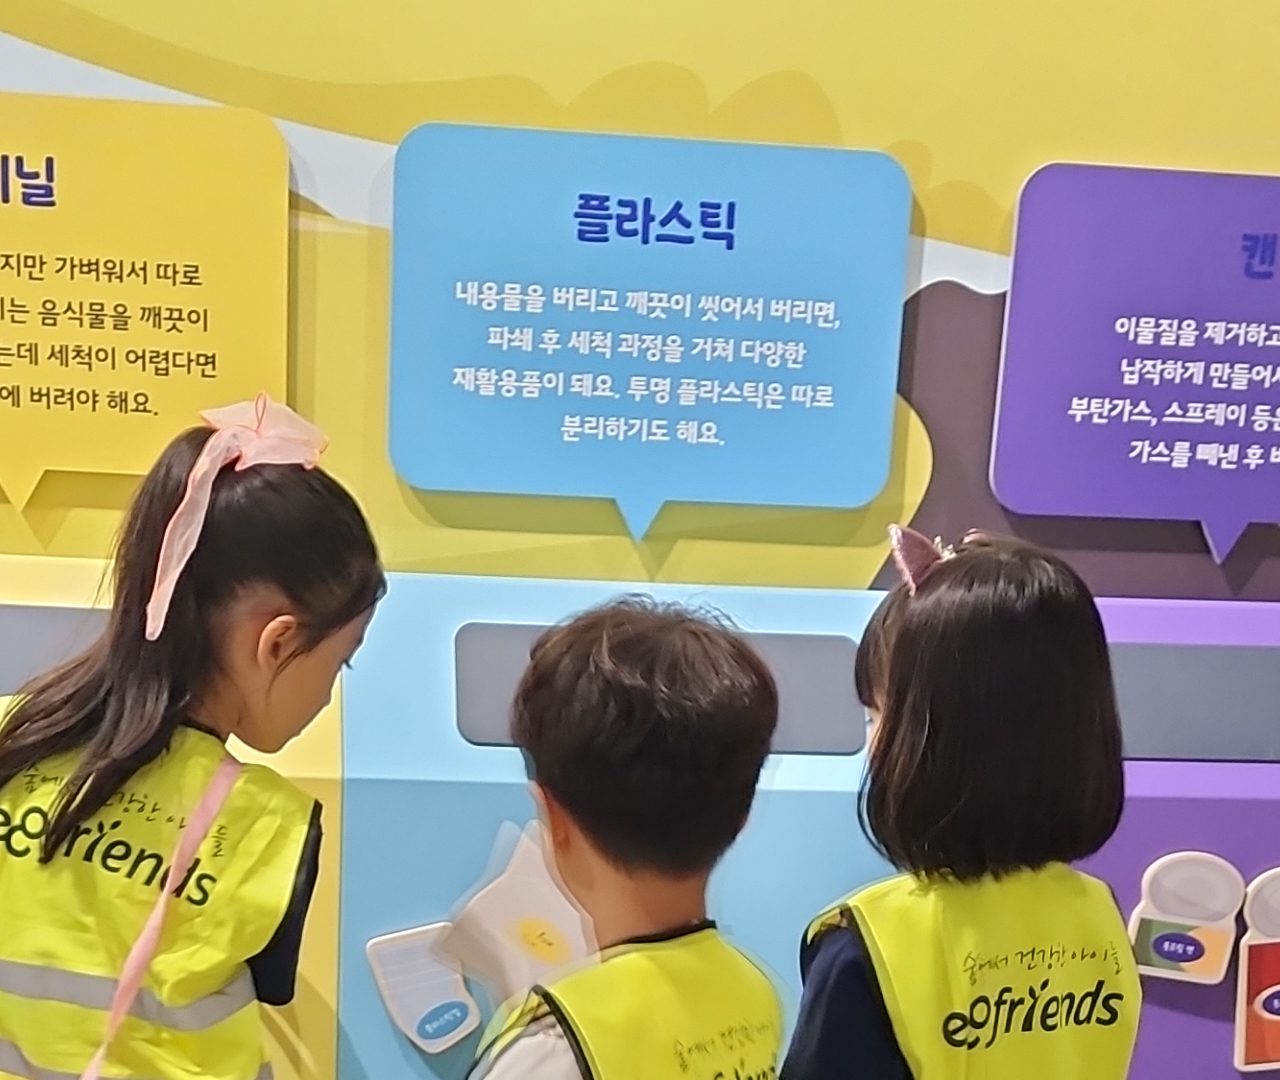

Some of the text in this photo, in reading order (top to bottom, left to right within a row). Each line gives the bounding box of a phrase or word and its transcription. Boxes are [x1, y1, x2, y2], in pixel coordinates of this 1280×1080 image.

[573, 193, 736, 251] 플라스틱
[54, 256, 148, 285] 가벼워서
[156, 263, 203, 287] 따로
[1241, 233, 1279, 281] 캔
[37, 299, 132, 332] 음식물을
[139, 306, 208, 334] 깨끗이
[455, 281, 841, 329] 내용물을 버리고 깨끗이 씻어서 버리면,
[487, 326, 807, 369] 파쇄 후 세척 과정을 거쳐 다양한
[1114, 316, 1199, 347] 이물질을
[47, 344, 116, 372] 세척이
[124, 348, 217, 379] 어렵다면
[1120, 358, 1205, 386] 납작하게
[29, 386, 100, 413] 버려야
[106, 390, 159, 416] 해요.
[452, 367, 834, 410] 재활용품이 돼요. 투명 플라스틱은 따로
[1067, 396, 1158, 427] 부탄가스,
[1162, 401, 1247, 428] 스프레이
[560, 414, 725, 446] 분리하기도 해요.
[1128, 440, 1192, 469] 가스를
[1242, 444, 1265, 470] 후
